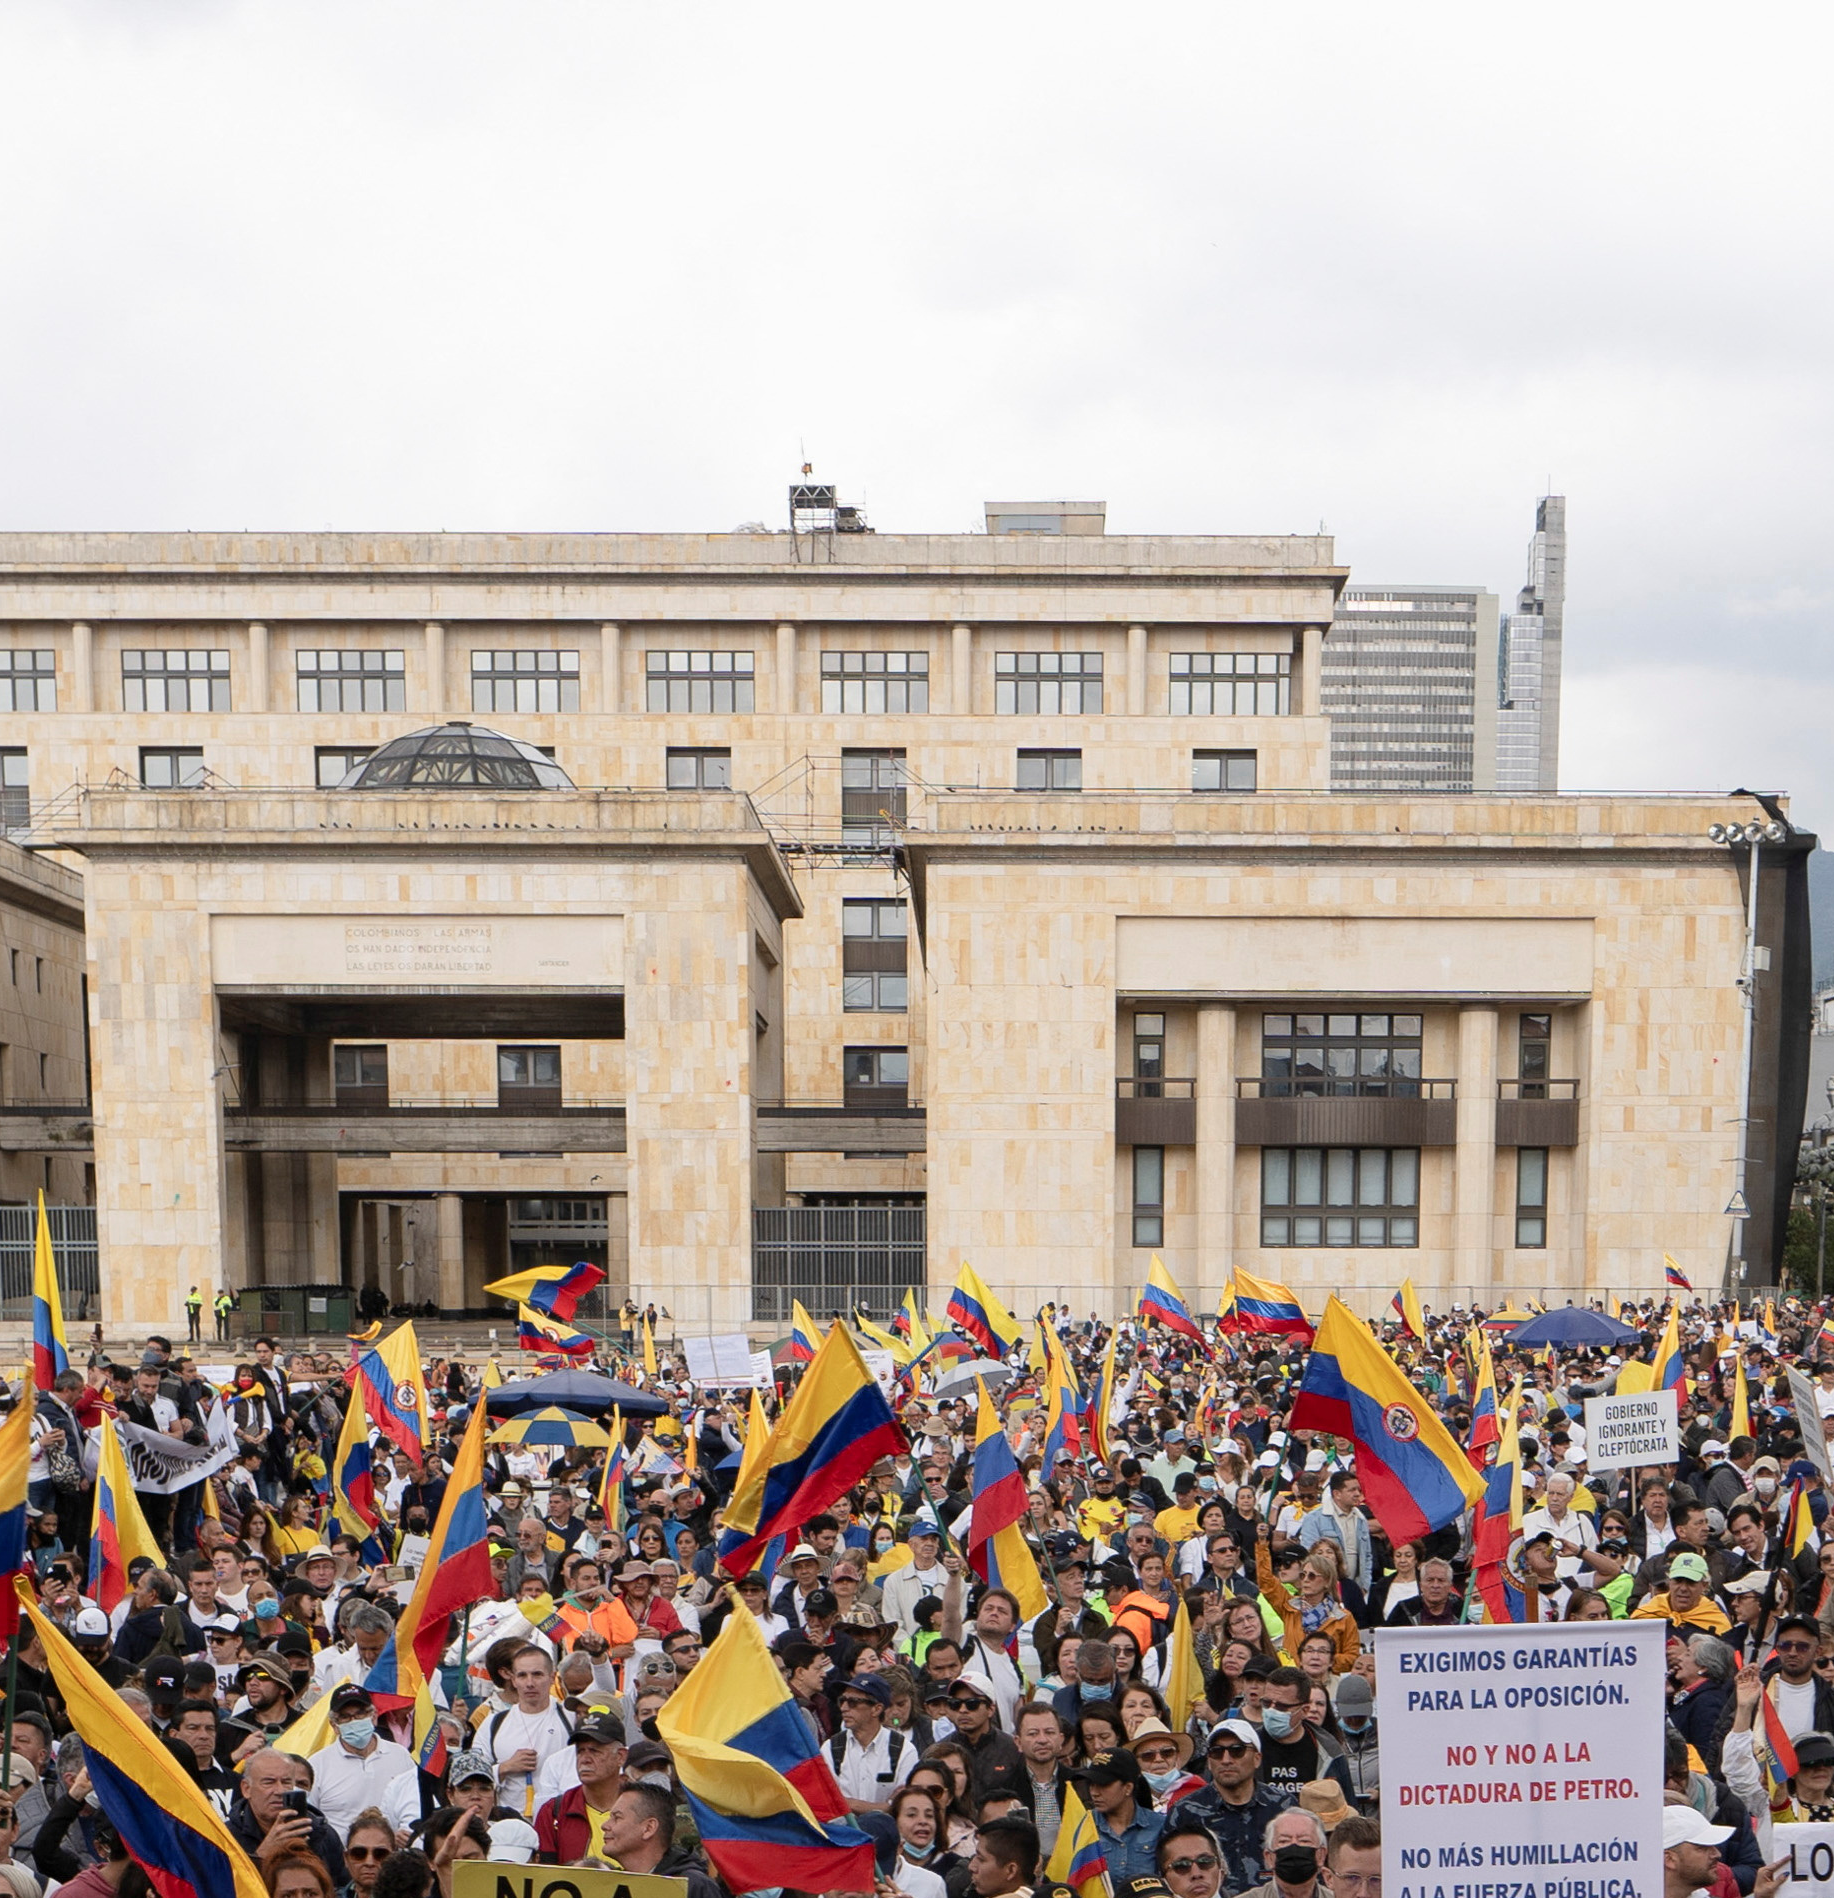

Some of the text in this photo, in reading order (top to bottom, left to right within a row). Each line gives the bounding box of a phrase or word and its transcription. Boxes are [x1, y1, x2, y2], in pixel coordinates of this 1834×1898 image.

[347, 928, 492, 938] COLOMBIANOS LAS ARMAS
[346, 944, 492, 954] OS HAN DADO INDEPENDENCIA
[347, 962, 365, 971] LAS
[368, 962, 395, 971] LEYES
[448, 962, 493, 971] LIBERTAD
[1605, 1402, 1658, 1421] GOBIERNO
[1598, 1418, 1667, 1440] IGNORANTE Y
[1398, 1642, 1638, 1675] EXIGIMOS GARANTÍAS
[1407, 1680, 1631, 1712] PARA LA OPOSICIÓN.
[1446, 1742, 1592, 1768] NO Y NO A LA
[1271, 1766, 1298, 1779] PAS
[1398, 1778, 1640, 1807] DICTADURA DE PETRO.
[1400, 1837, 1638, 1870] NO MÁS HUMILLACIÓN
